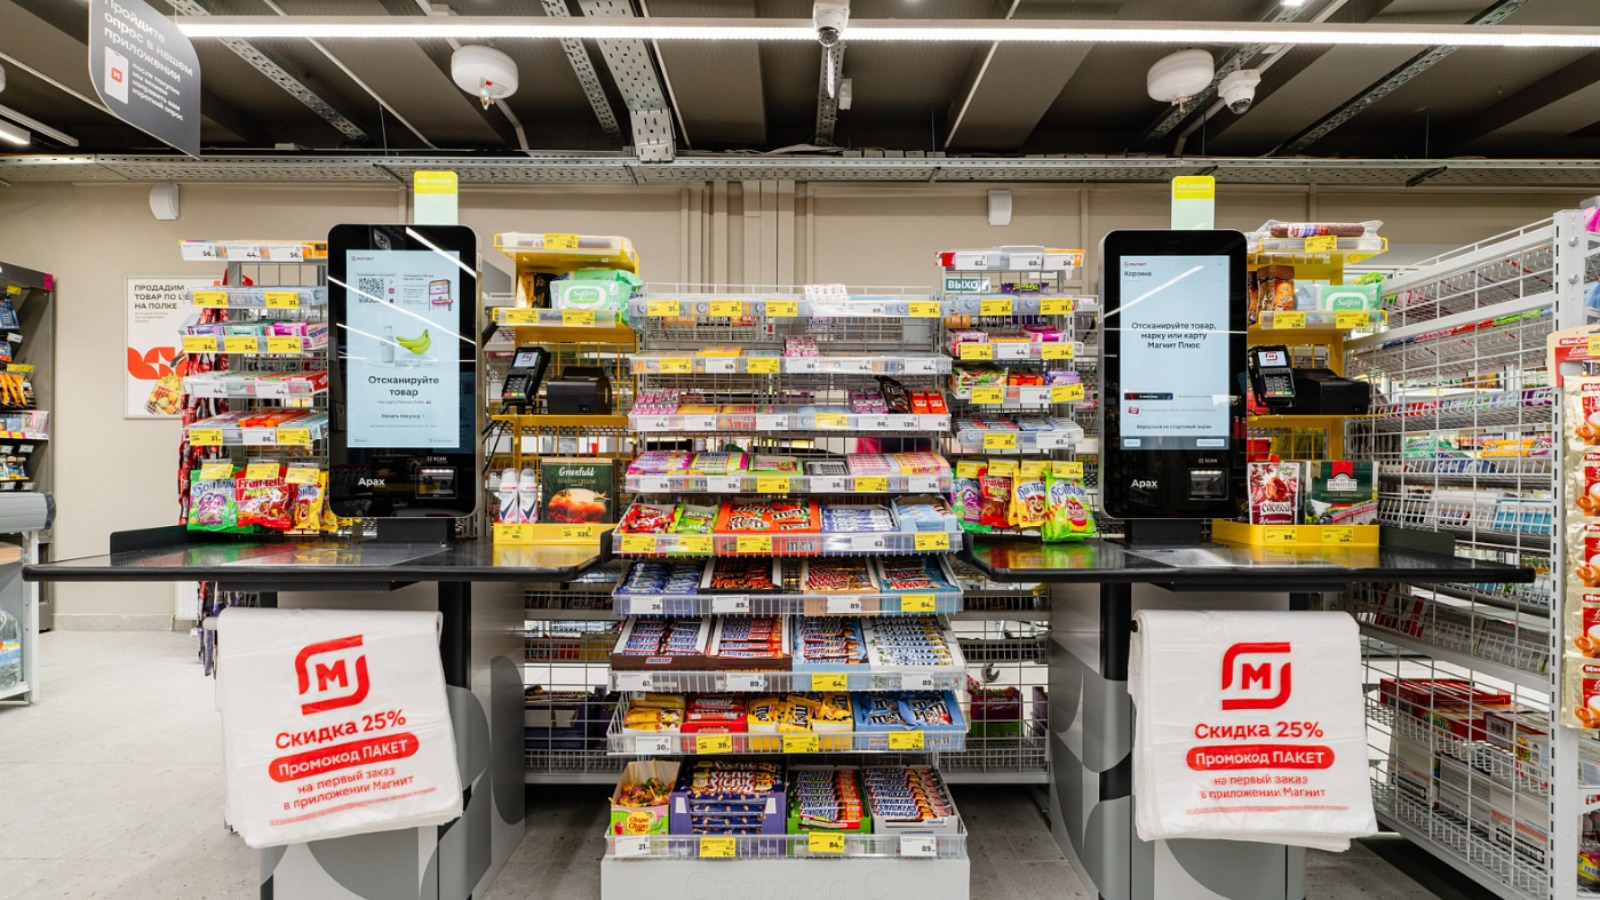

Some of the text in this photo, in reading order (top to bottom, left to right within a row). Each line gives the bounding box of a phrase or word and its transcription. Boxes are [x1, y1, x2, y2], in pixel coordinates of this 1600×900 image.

[105, 0, 165, 43] Пройдите
[104, 12, 193, 77] опрос в нашем
[104, 27, 181, 83] приложении
[132, 63, 180, 96] после покупки
[132, 71, 168, 96] мы можем
[132, 79, 180, 111] направить вам
[132, 87, 183, 121] короткий опрос
[948, 280, 981, 290] ВЫХО
[135, 302, 178, 310] НА ПОЛКЕ
[1131, 322, 1217, 331] Отсканируйте товар,
[368, 376, 439, 386] Отсканируйте
[390, 388, 418, 398] товар
[559, 467, 595, 477] Greenfield
[275, 708, 406, 750] Скидка 25%
[1194, 721, 1324, 740] Скидка 25%
[278, 739, 408, 778] Промокод ПАКЕТ
[1195, 751, 1324, 767] Промокод ПАКЕТ
[284, 802, 290, 810] в
[294, 784, 370, 810] приложении
[373, 775, 414, 791] Магнит
[298, 767, 395, 794] на первый заказ
[1214, 774, 1308, 788] на первый заказ
[1209, 789, 1280, 801] приложении
[1283, 788, 1326, 798] Магнит
